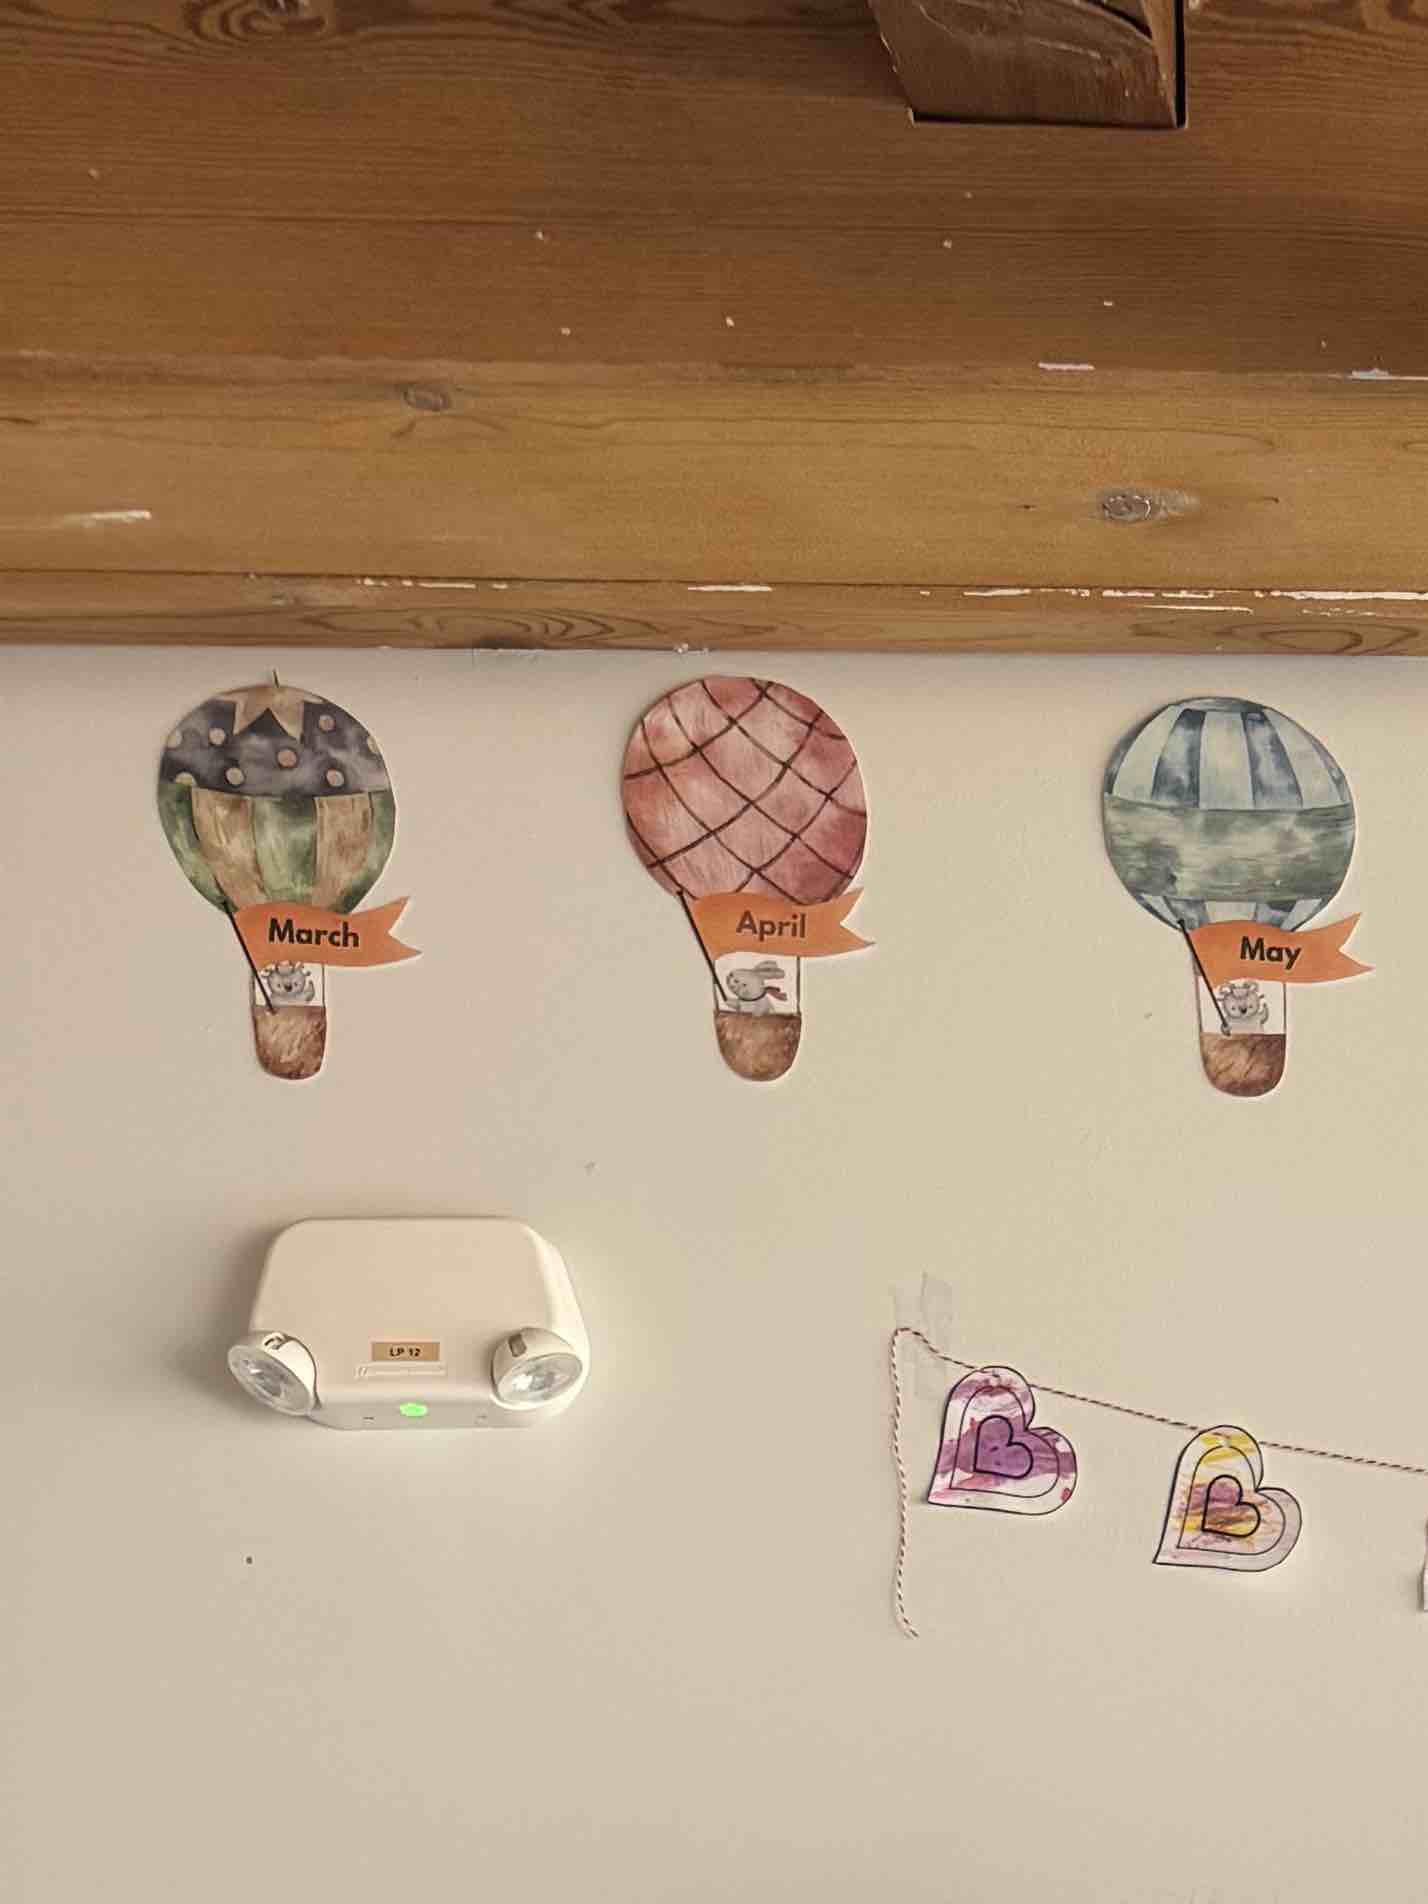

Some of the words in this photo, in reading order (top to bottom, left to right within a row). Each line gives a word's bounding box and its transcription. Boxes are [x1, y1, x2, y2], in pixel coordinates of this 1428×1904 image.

[268, 917, 360, 948] March
[735, 910, 808, 942] April
[1239, 935, 1302, 971] May
